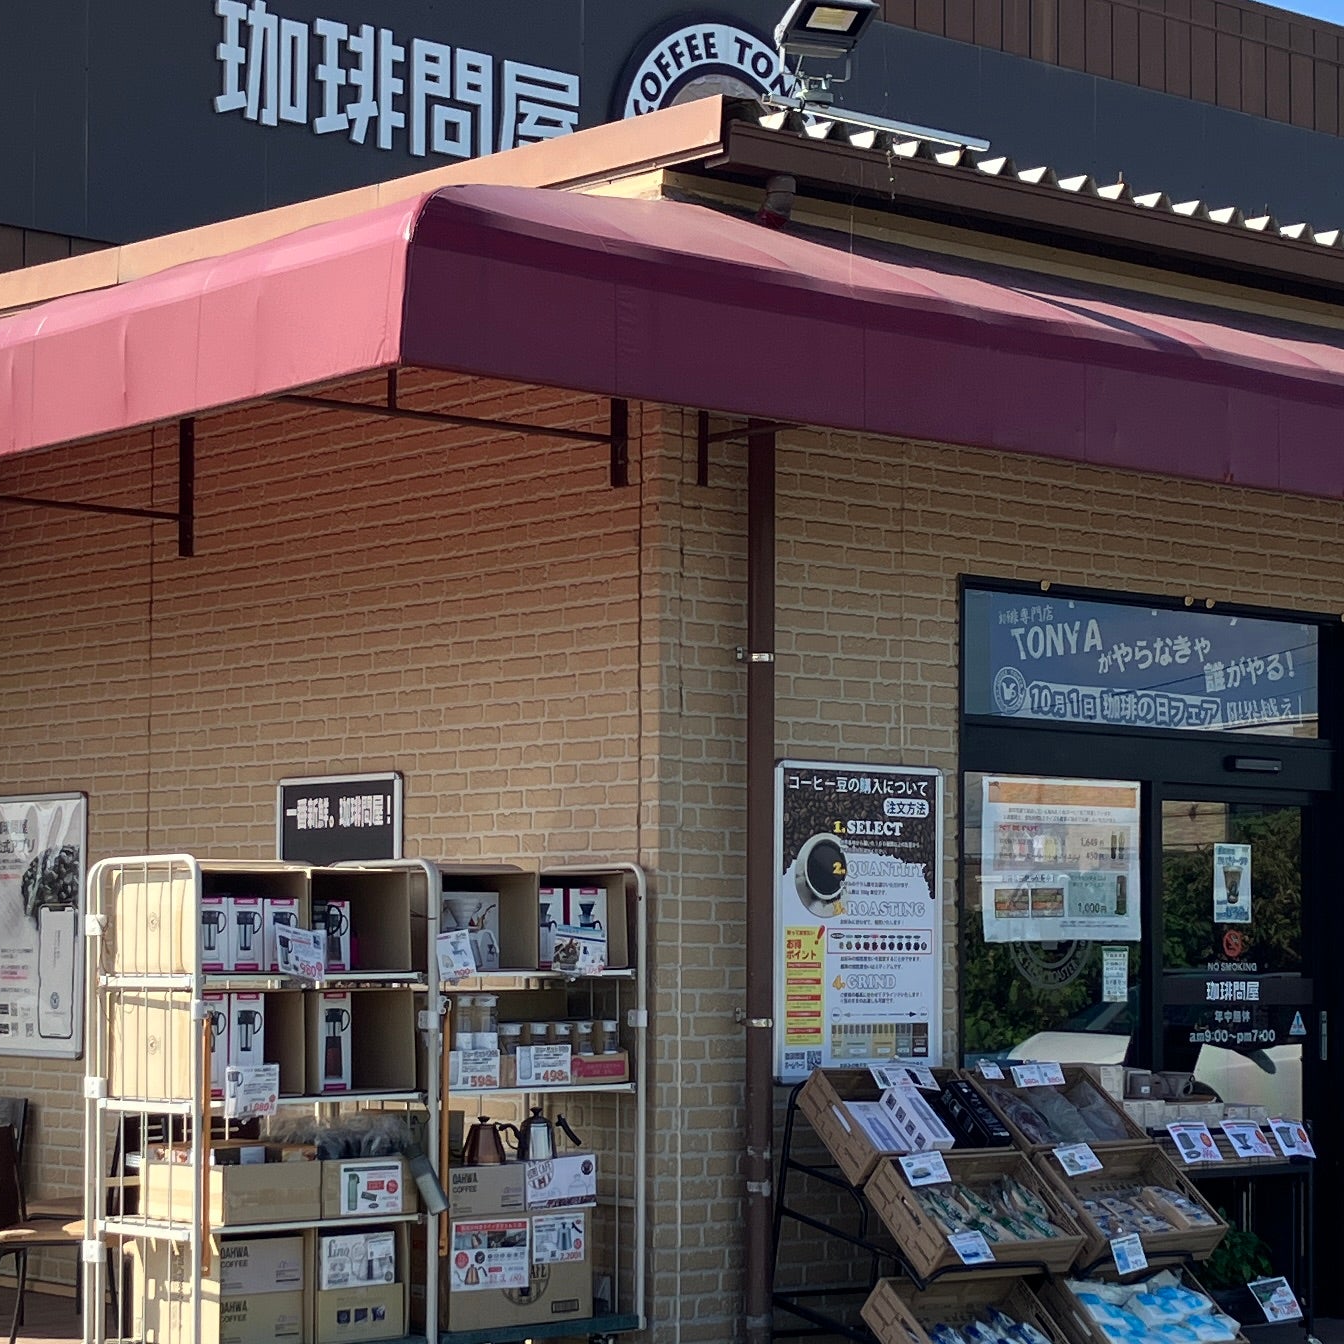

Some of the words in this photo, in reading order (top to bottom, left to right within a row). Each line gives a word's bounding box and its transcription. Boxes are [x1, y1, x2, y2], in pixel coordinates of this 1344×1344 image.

[214, 0, 579, 157] 珈琲問屋
[633, 31, 719, 116] COFFEE
[734, 36, 794, 98] TON
[1010, 618, 1103, 660] TONYA
[789, 775, 929, 797] コーヒー豆の購入について
[886, 801, 927, 816] 注文方法
[786, 949, 818, 961] ポイント
[1207, 962, 1219, 971] NO
[1220, 962, 1257, 971] SMOKING
[1206, 981, 1259, 1001] 珈琲問屋
[452, 1185, 478, 1194] COFFEE
[220, 1260, 249, 1269] COFFEE
